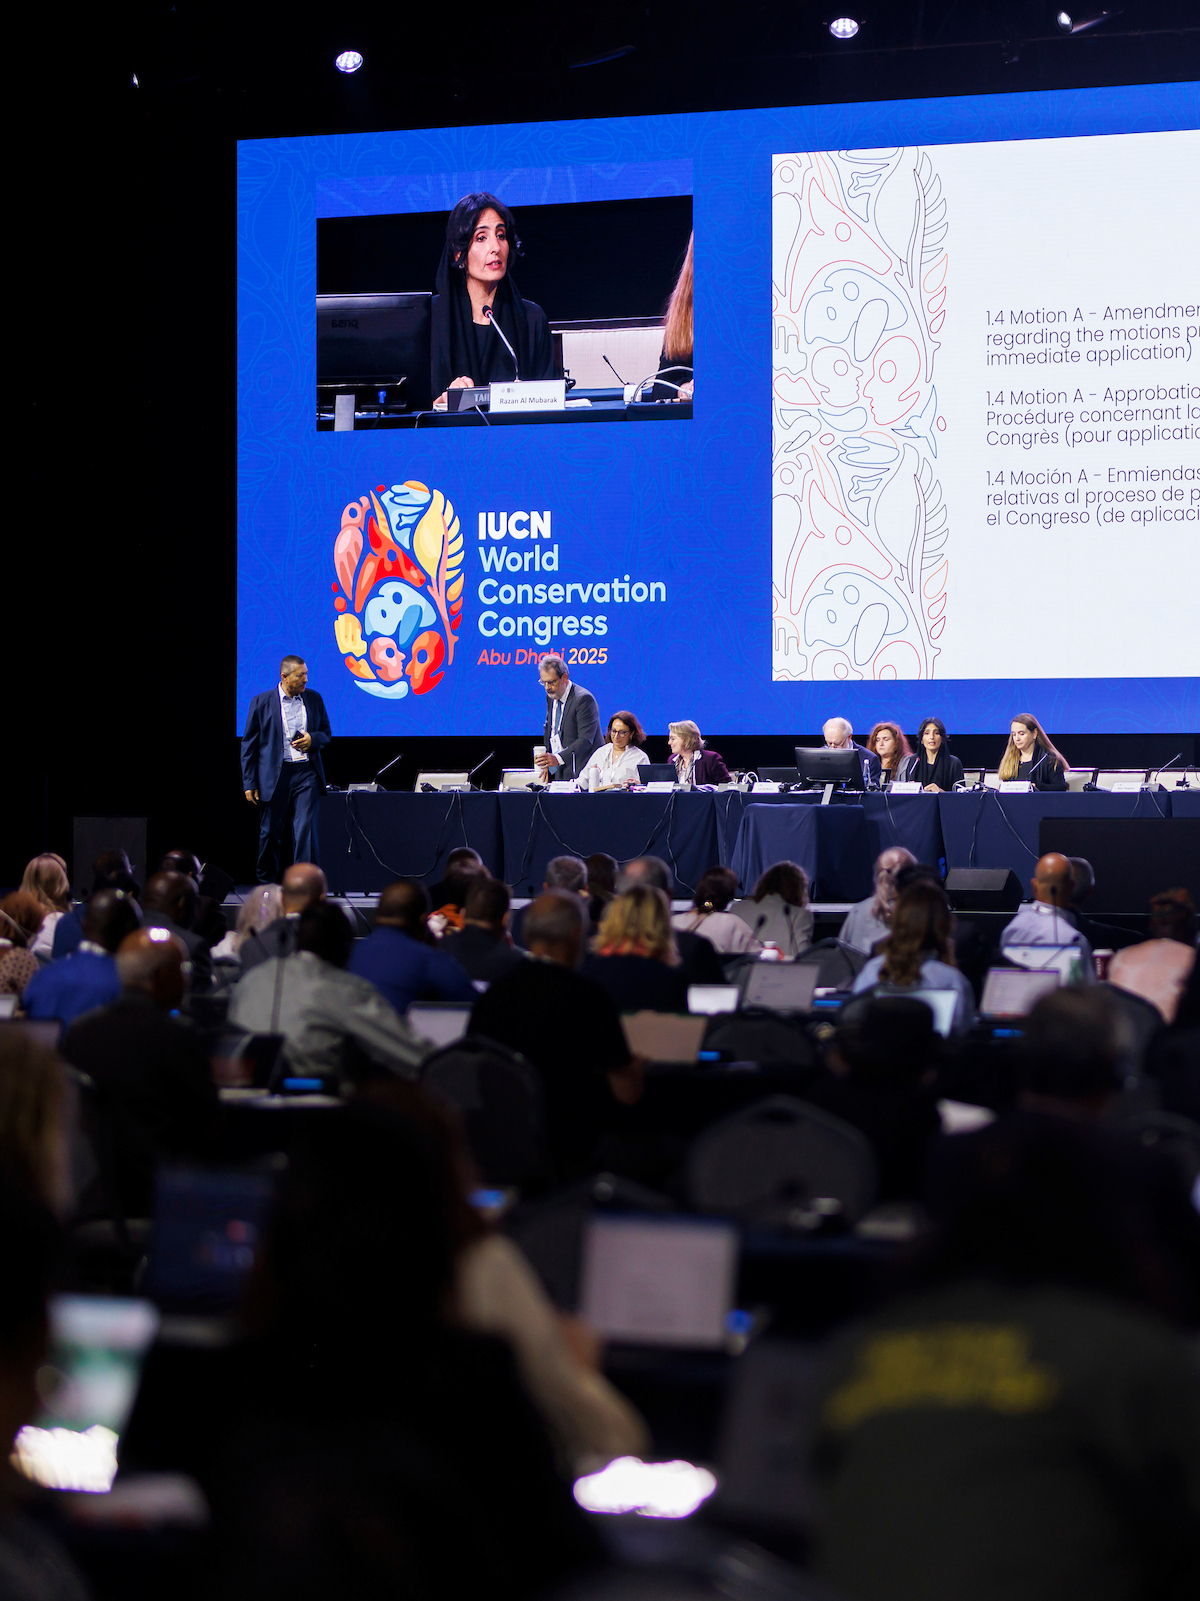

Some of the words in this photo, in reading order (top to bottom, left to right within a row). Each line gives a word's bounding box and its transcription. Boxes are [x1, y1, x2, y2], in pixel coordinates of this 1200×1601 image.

[986, 310, 1004, 326] 1.4
[1010, 308, 1067, 325] Motion
[1073, 307, 1083, 322] A
[987, 328, 1070, 350] regarding
[1076, 327, 1104, 342] the
[1110, 323, 1181, 341] motions
[987, 348, 1081, 366] immediate
[1086, 341, 1192, 366] application)
[528, 396, 558, 404] Mubarak
[986, 390, 1004, 406] 1.4
[1010, 389, 1067, 405] Motion
[1073, 388, 1083, 403] A
[987, 408, 1074, 426] Procédure
[1080, 405, 1181, 423] concernant
[986, 429, 1058, 450] Congrès
[1064, 424, 1112, 447] (pour
[986, 470, 1004, 486] 1.4
[1010, 469, 1071, 485] Moción
[1077, 469, 1088, 484] A
[987, 489, 1058, 506] relativas
[1064, 488, 1080, 503] al
[1086, 488, 1156, 508] proceso
[1162, 485, 1184, 501] de
[478, 511, 551, 540] IUCN
[986, 510, 1000, 526] el
[1006, 509, 1090, 529] Congreso
[1096, 503, 1125, 526] (de
[478, 544, 559, 572] World
[478, 574, 666, 604] Conservation
[478, 611, 608, 645] Congress
[477, 649, 511, 665] Abu
[568, 648, 608, 664] 2025
